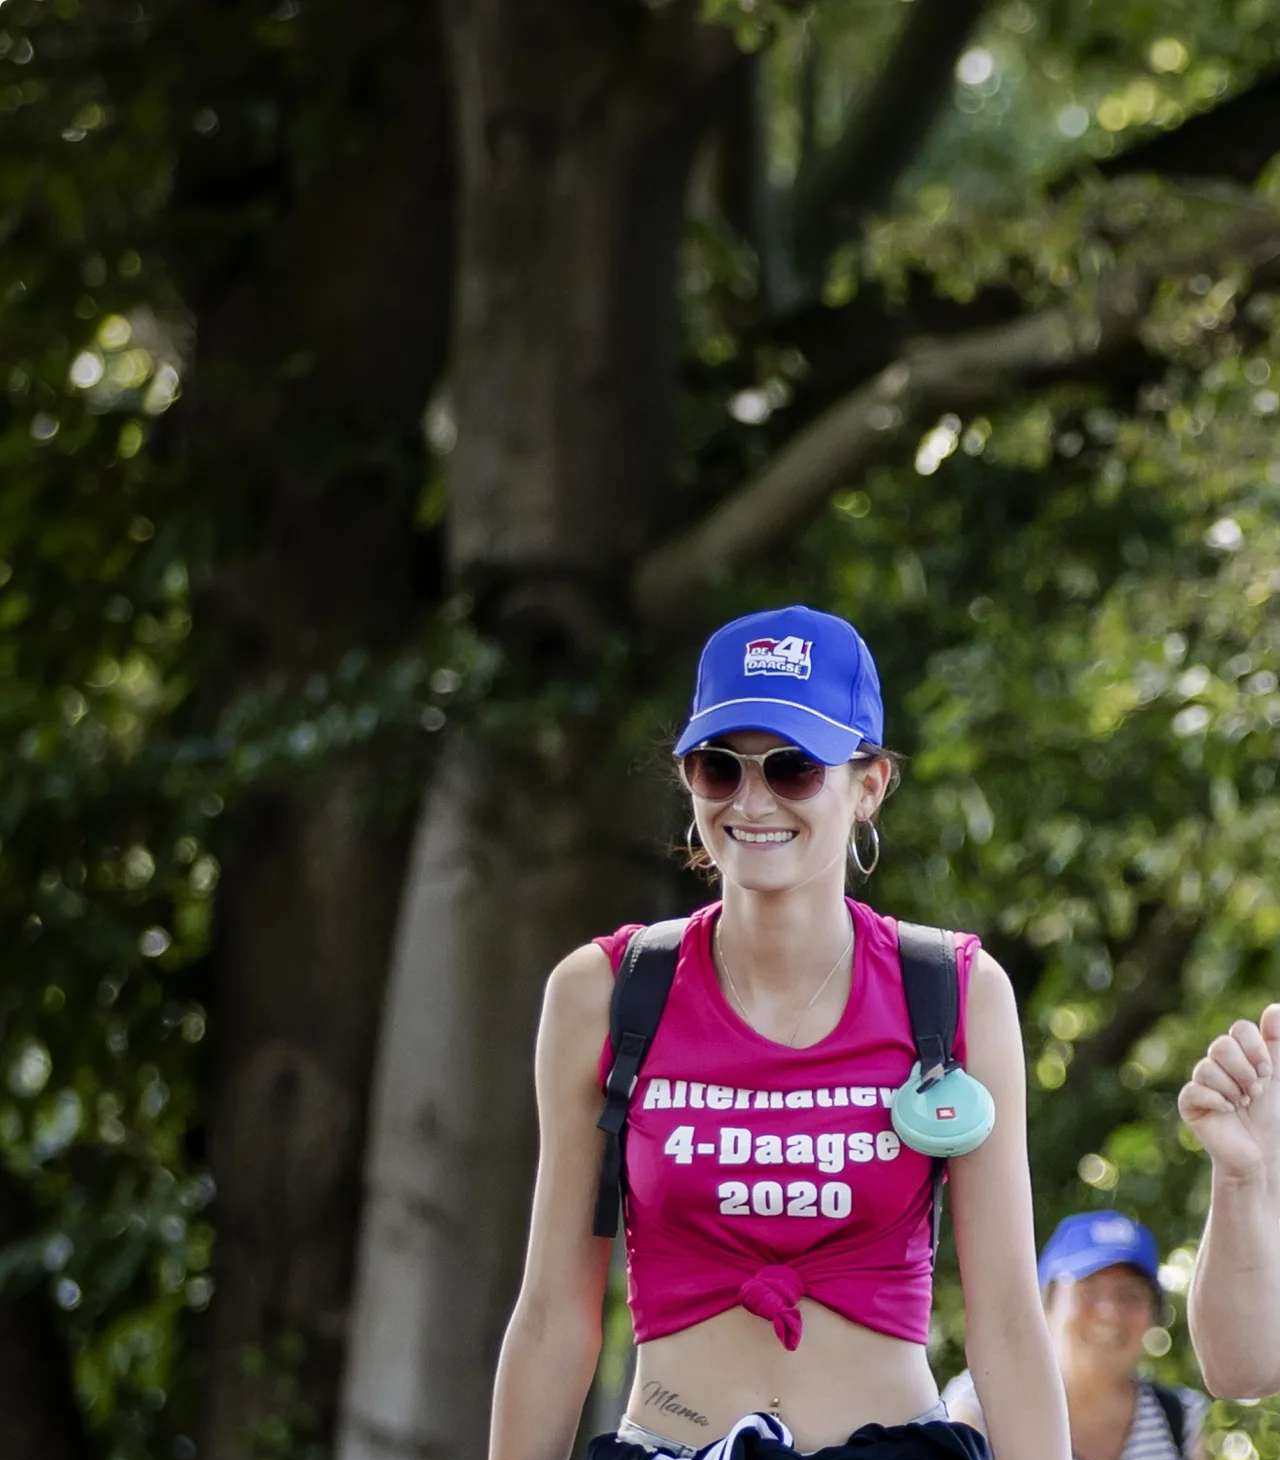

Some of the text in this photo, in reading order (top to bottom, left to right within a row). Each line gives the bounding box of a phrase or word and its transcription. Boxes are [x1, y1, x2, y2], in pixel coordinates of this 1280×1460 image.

[748, 660, 802, 674] DAAGSE
[773, 636, 804, 663] 4
[643, 1078, 899, 1110] Alternatiev
[664, 1125, 900, 1173] 4-Daagse
[718, 1181, 852, 1219] 2020
[642, 1381, 710, 1427] Mama
